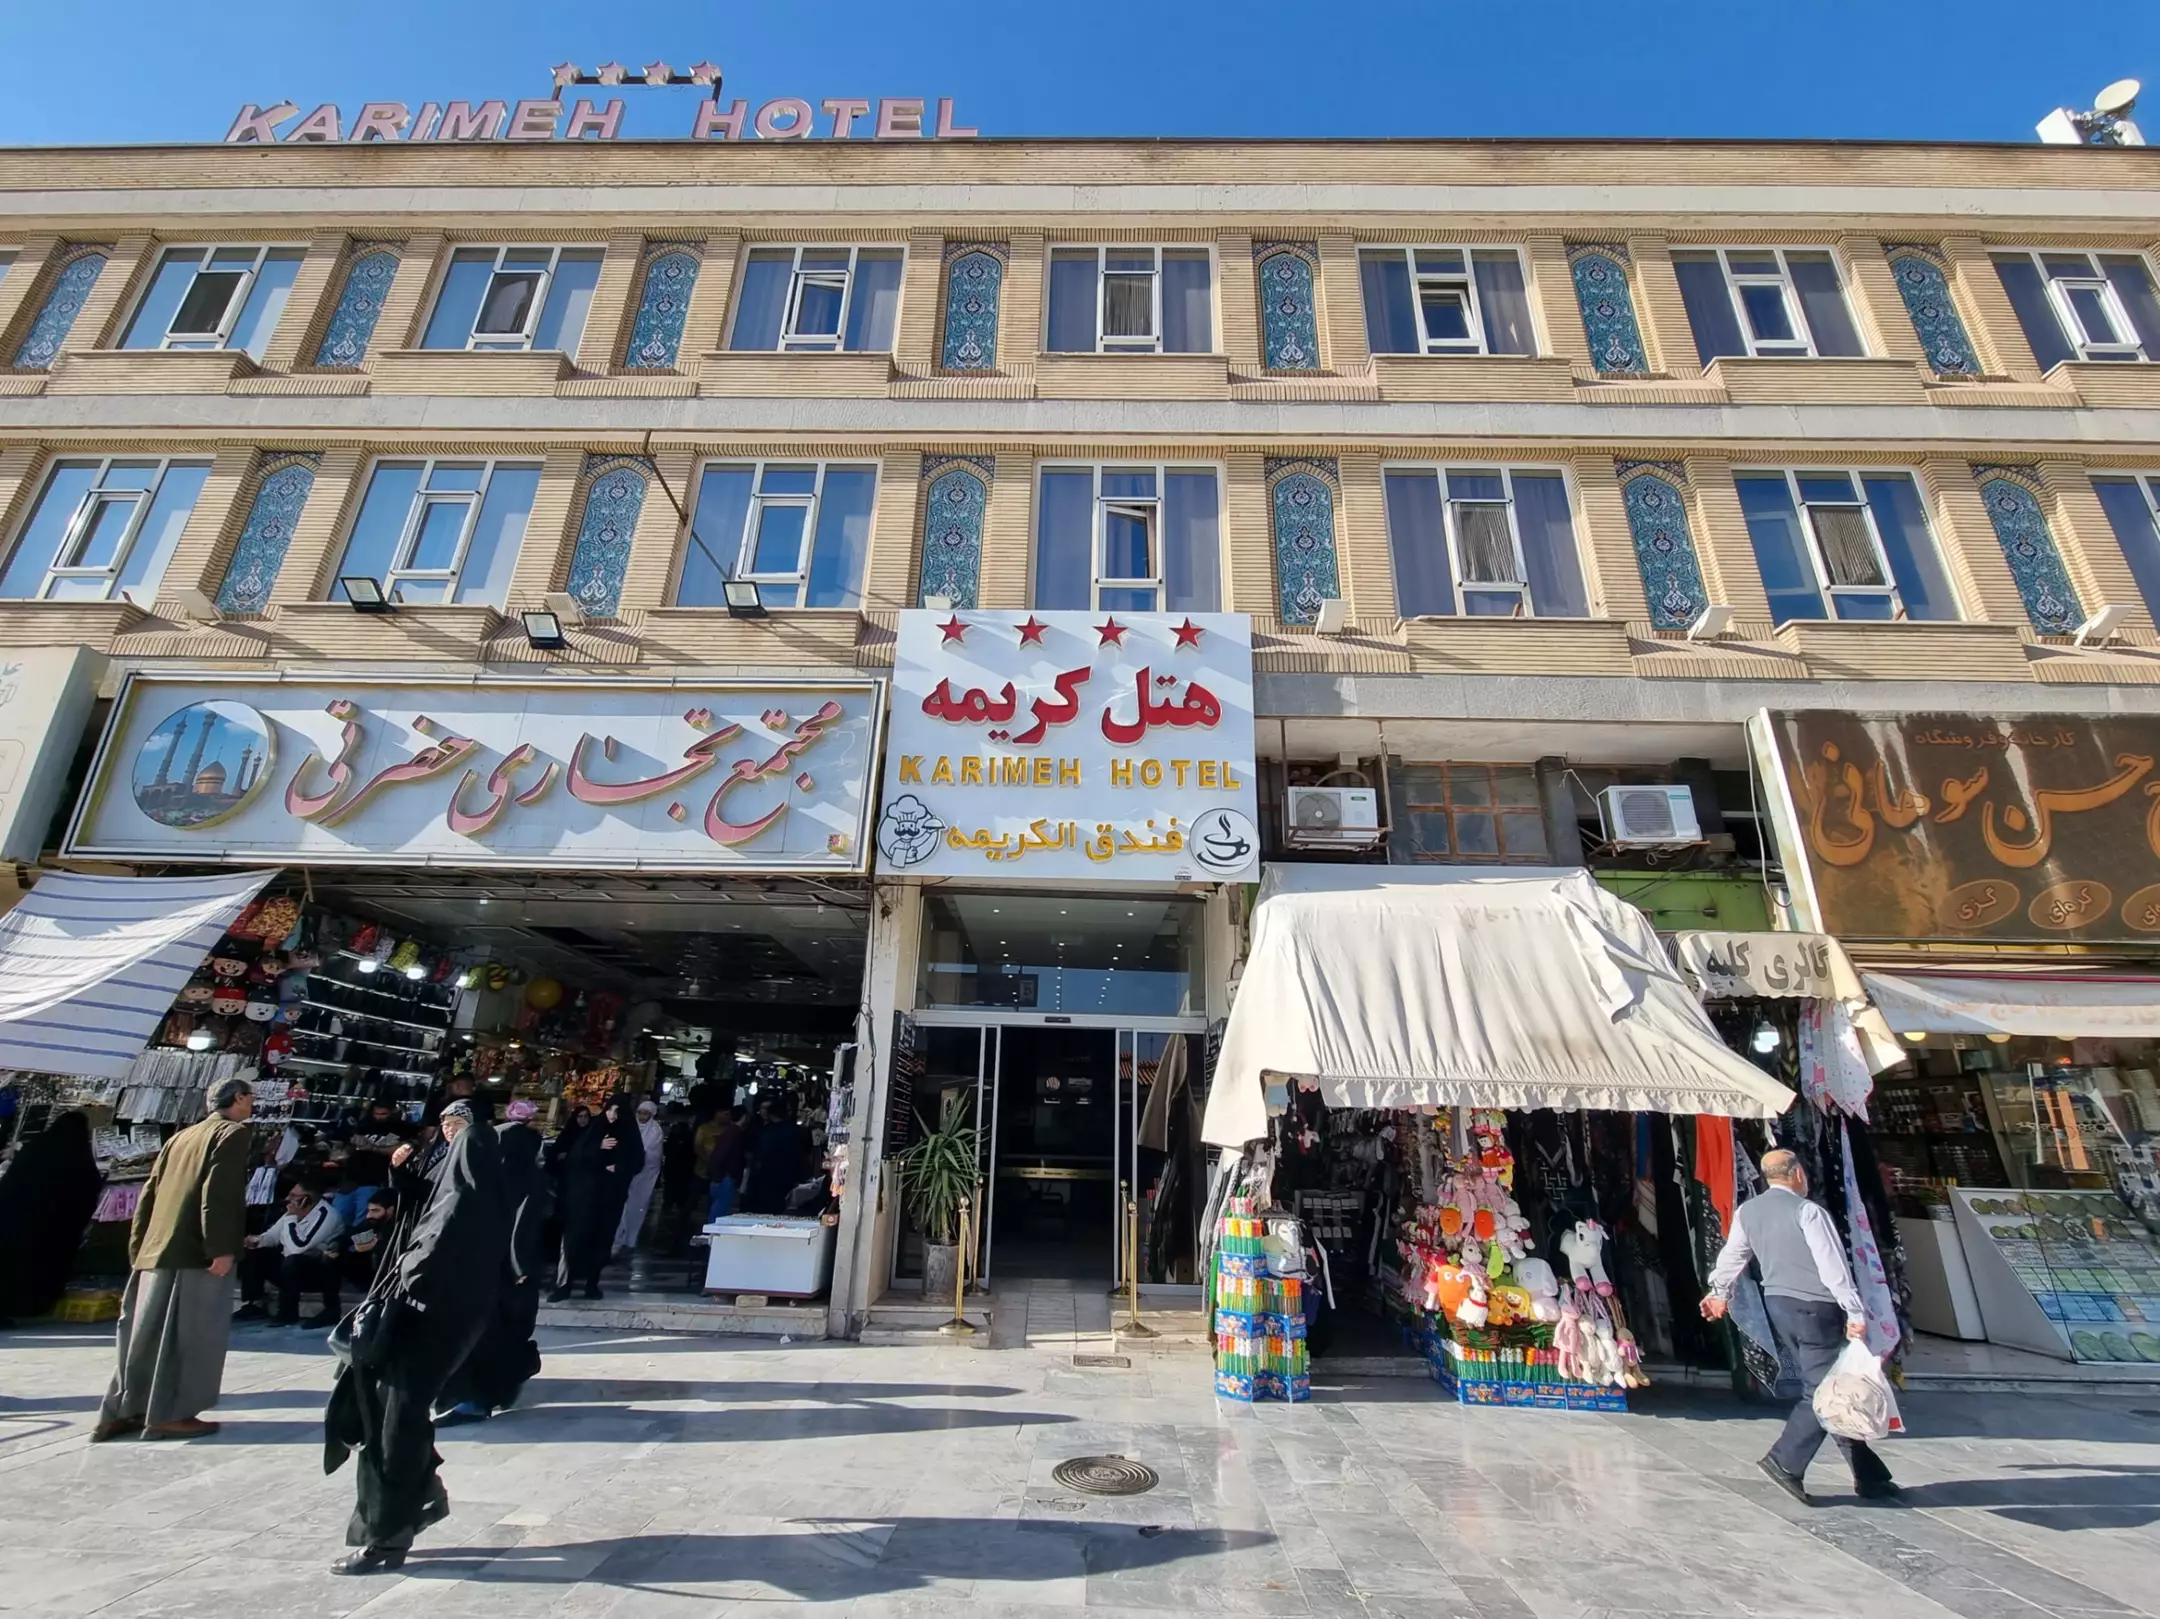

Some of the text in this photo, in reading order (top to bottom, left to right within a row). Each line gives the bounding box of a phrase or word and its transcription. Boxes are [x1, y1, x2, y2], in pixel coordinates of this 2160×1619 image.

[224, 97, 980, 142] KARIMEH HOTEL
[921, 665, 1223, 745] هتل کریمه
[704, 699, 844, 847] مجتمع
[898, 754, 1242, 790] KARIMEH HOTEL
[1982, 752, 2154, 869] حسن
[1085, 816, 1185, 863] فندق
[1764, 939, 1830, 991] گالری
